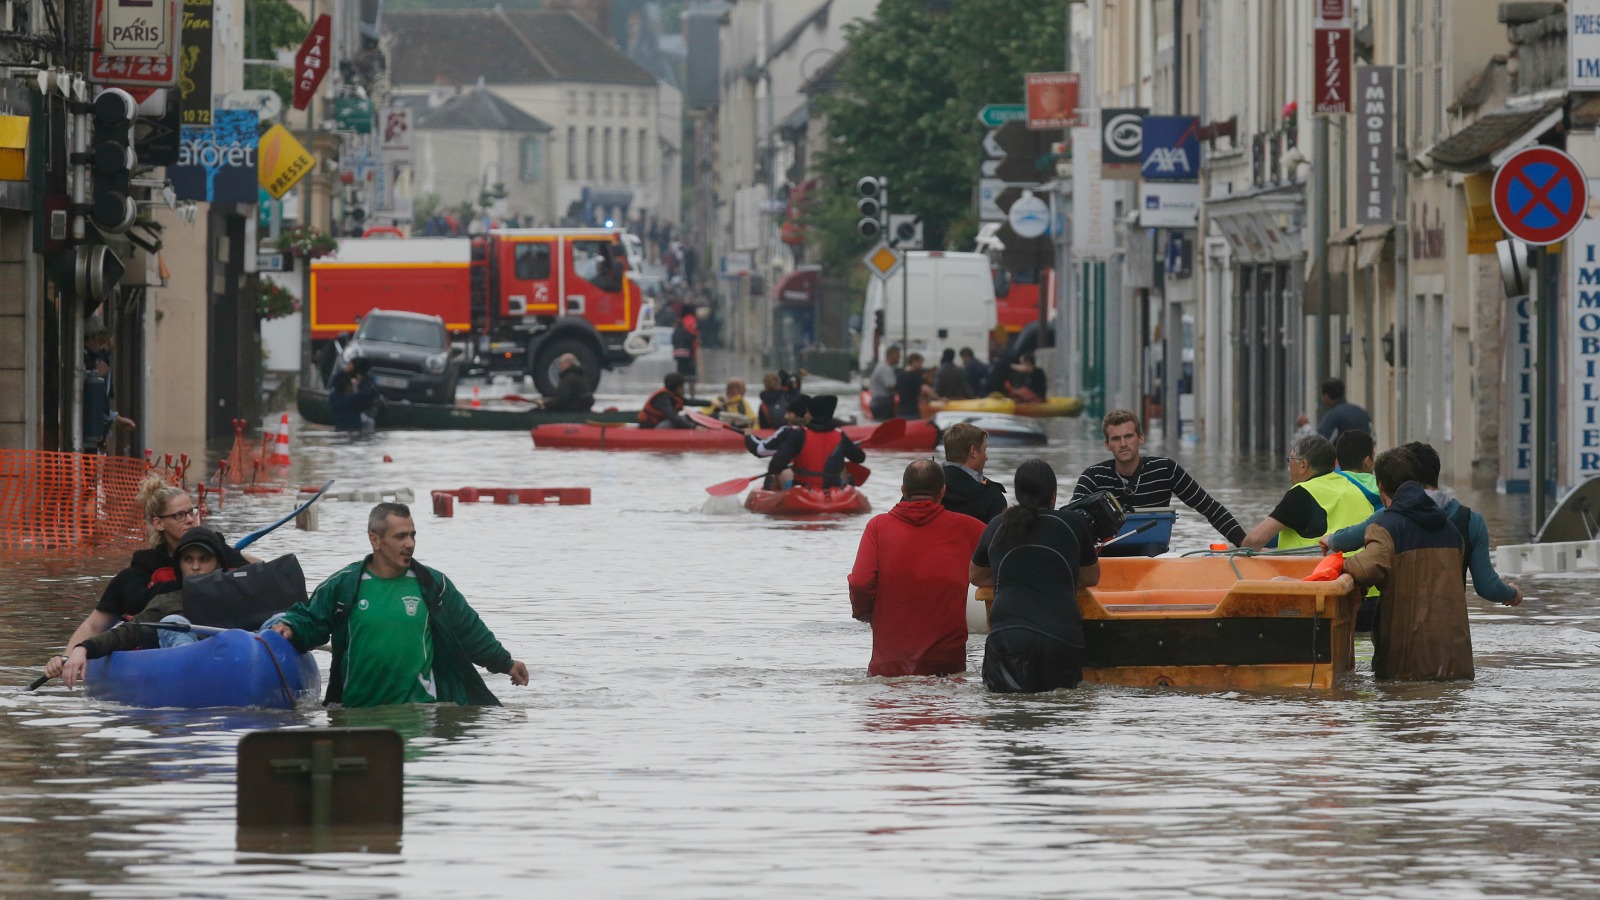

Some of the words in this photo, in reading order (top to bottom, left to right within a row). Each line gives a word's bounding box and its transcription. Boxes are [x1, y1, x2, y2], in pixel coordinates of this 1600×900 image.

[113, 26, 158, 41] PARIS
[95, 56, 168, 77] 24/24
[300, 34, 325, 91] TABAC
[1325, 31, 1340, 101] PIZZA
[183, 110, 195, 123] 10
[198, 110, 210, 123] 72
[177, 137, 254, 166] aforêt
[1141, 147, 1191, 172] AXA
[1365, 71, 1385, 220] IMMOBILIER
[270, 155, 309, 194] PRESSE
[1577, 244, 1600, 471] IMMOBILIER
